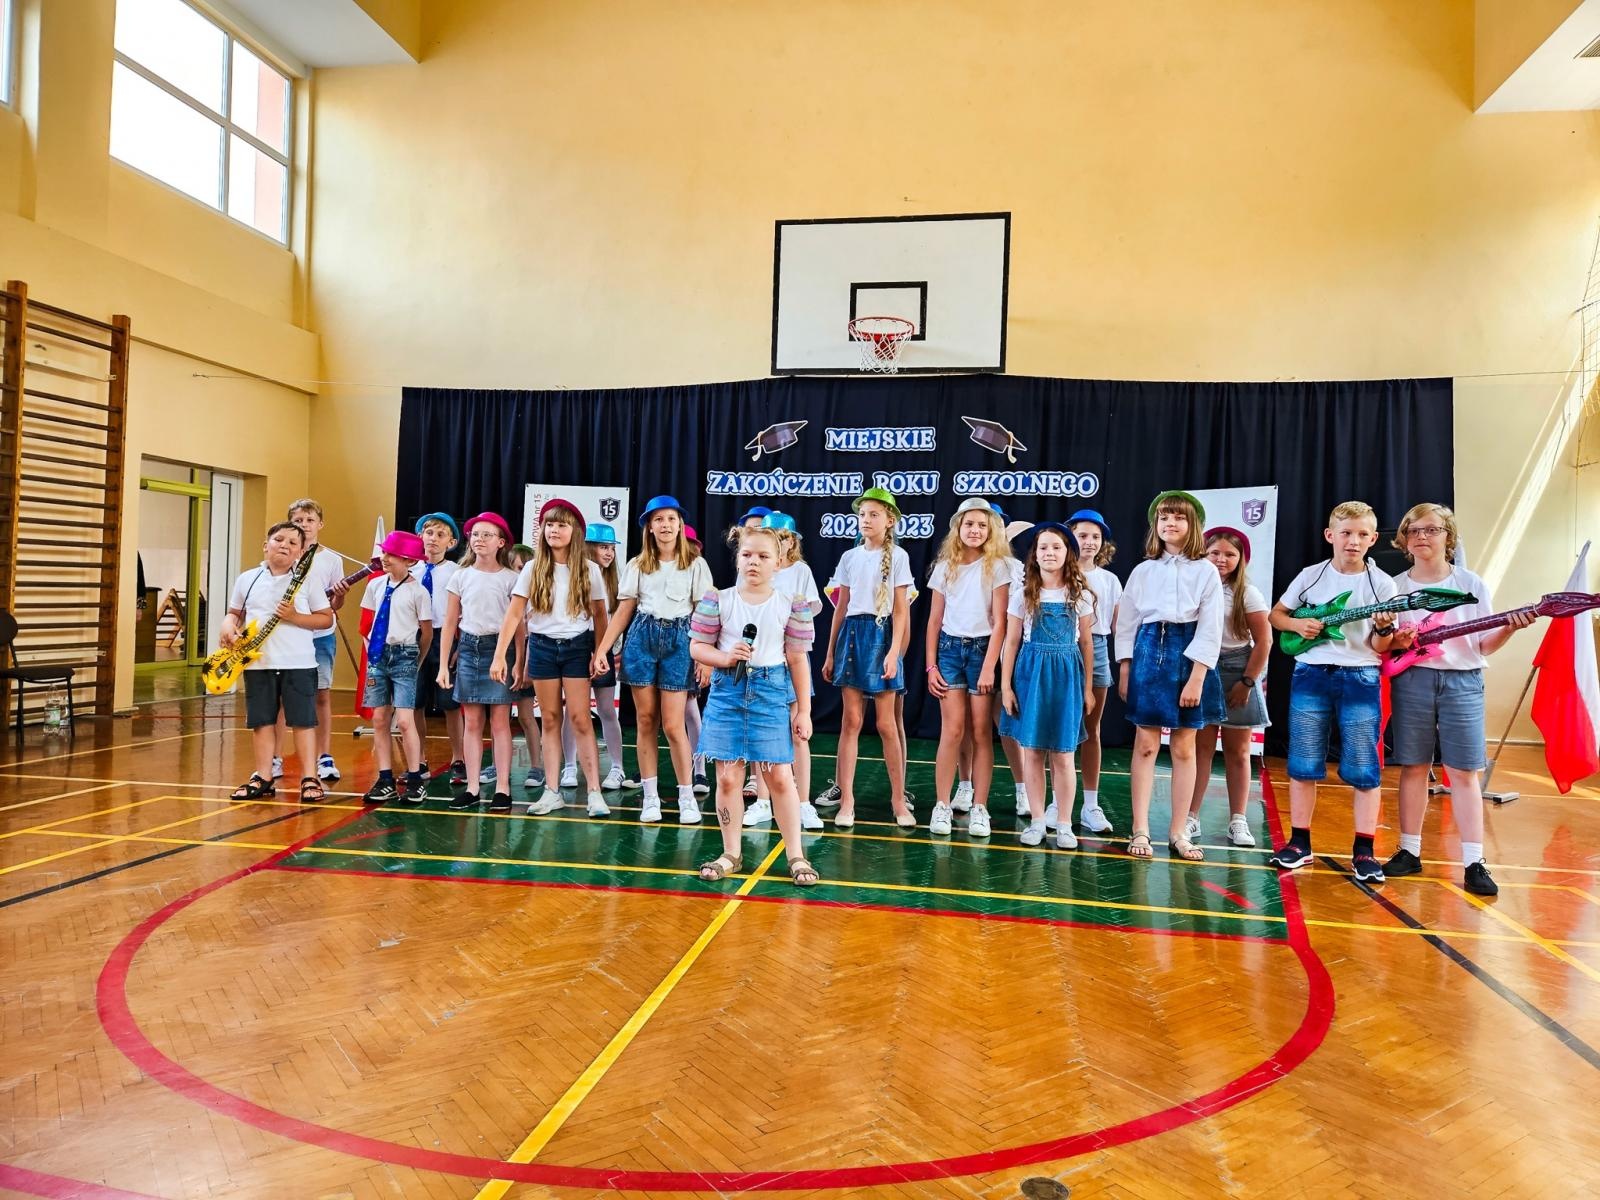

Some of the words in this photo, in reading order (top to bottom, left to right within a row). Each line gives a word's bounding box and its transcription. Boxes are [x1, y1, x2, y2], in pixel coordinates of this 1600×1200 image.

[826, 429, 934, 450] MIEJSKIE
[708, 470, 862, 495] ZAKOŃCZENIE
[874, 472, 939, 494] ROKU
[954, 473, 1098, 496] SZKOLNEGO
[603, 505, 616, 515] 15
[1246, 508, 1261, 520] 15
